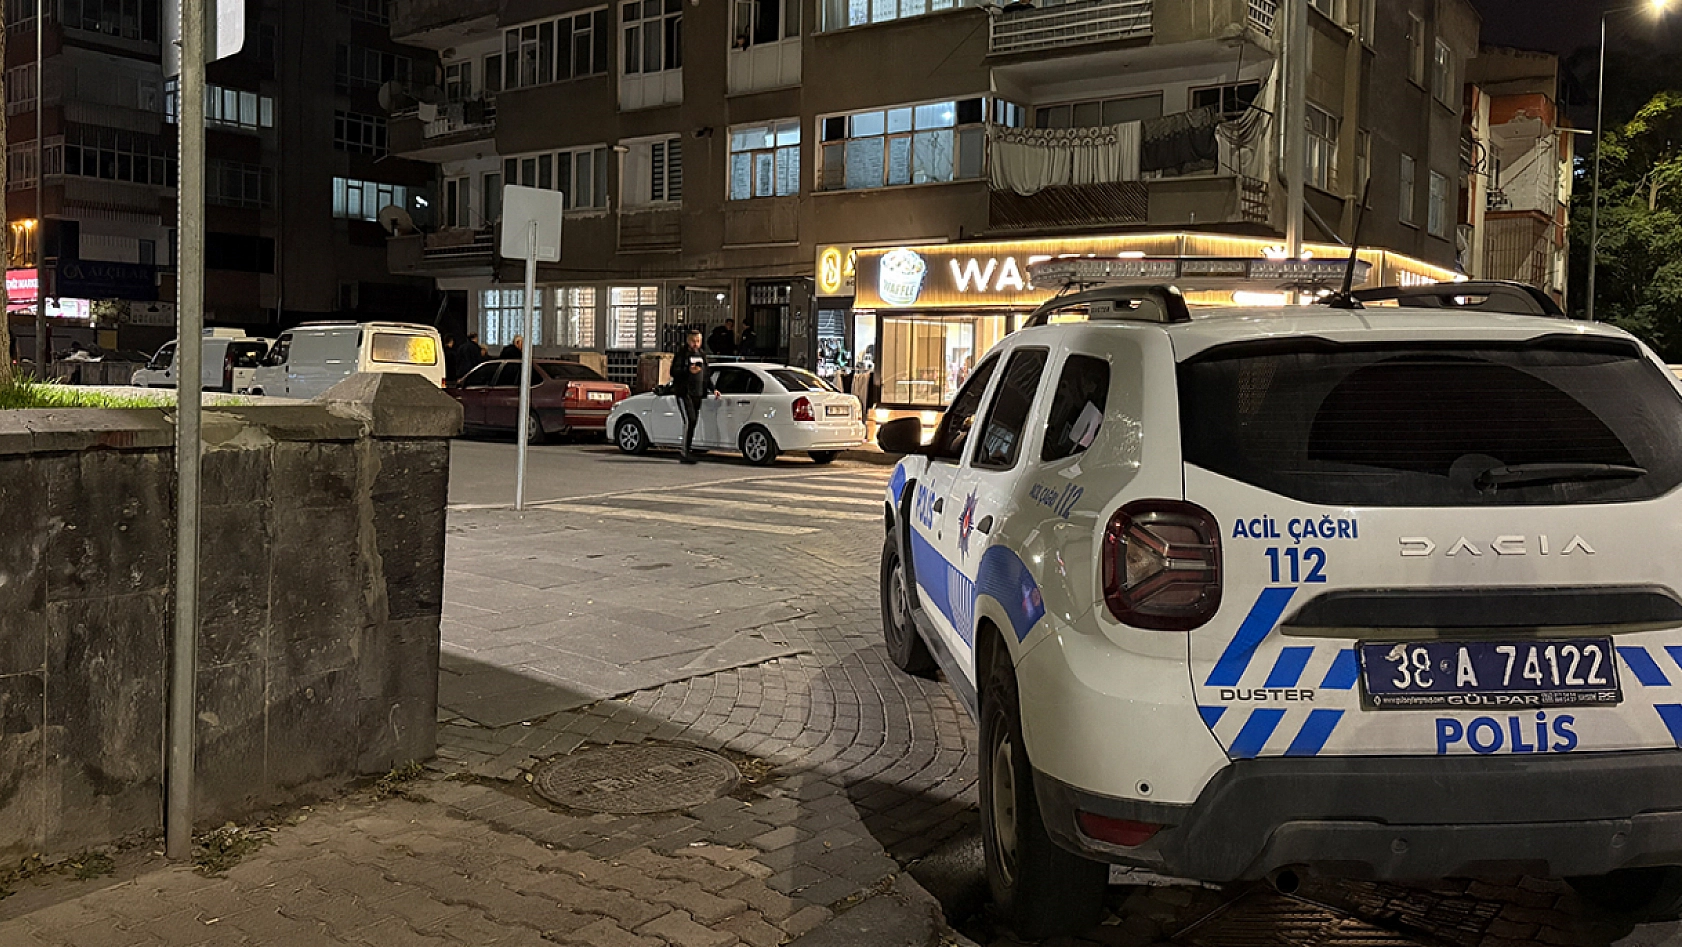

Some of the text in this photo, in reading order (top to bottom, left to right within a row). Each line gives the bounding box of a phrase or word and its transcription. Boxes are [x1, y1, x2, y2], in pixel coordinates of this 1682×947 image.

[1053, 482, 1085, 520] 112
[1232, 514, 1359, 545] ACİL ÇAĞRI
[1400, 534, 1596, 557] DACIA
[1264, 546, 1327, 583] 112
[1388, 645, 1608, 689] 38 A 74122
[1220, 688, 1315, 702] DUSTER
[1447, 693, 1541, 706] GÜLPAR
